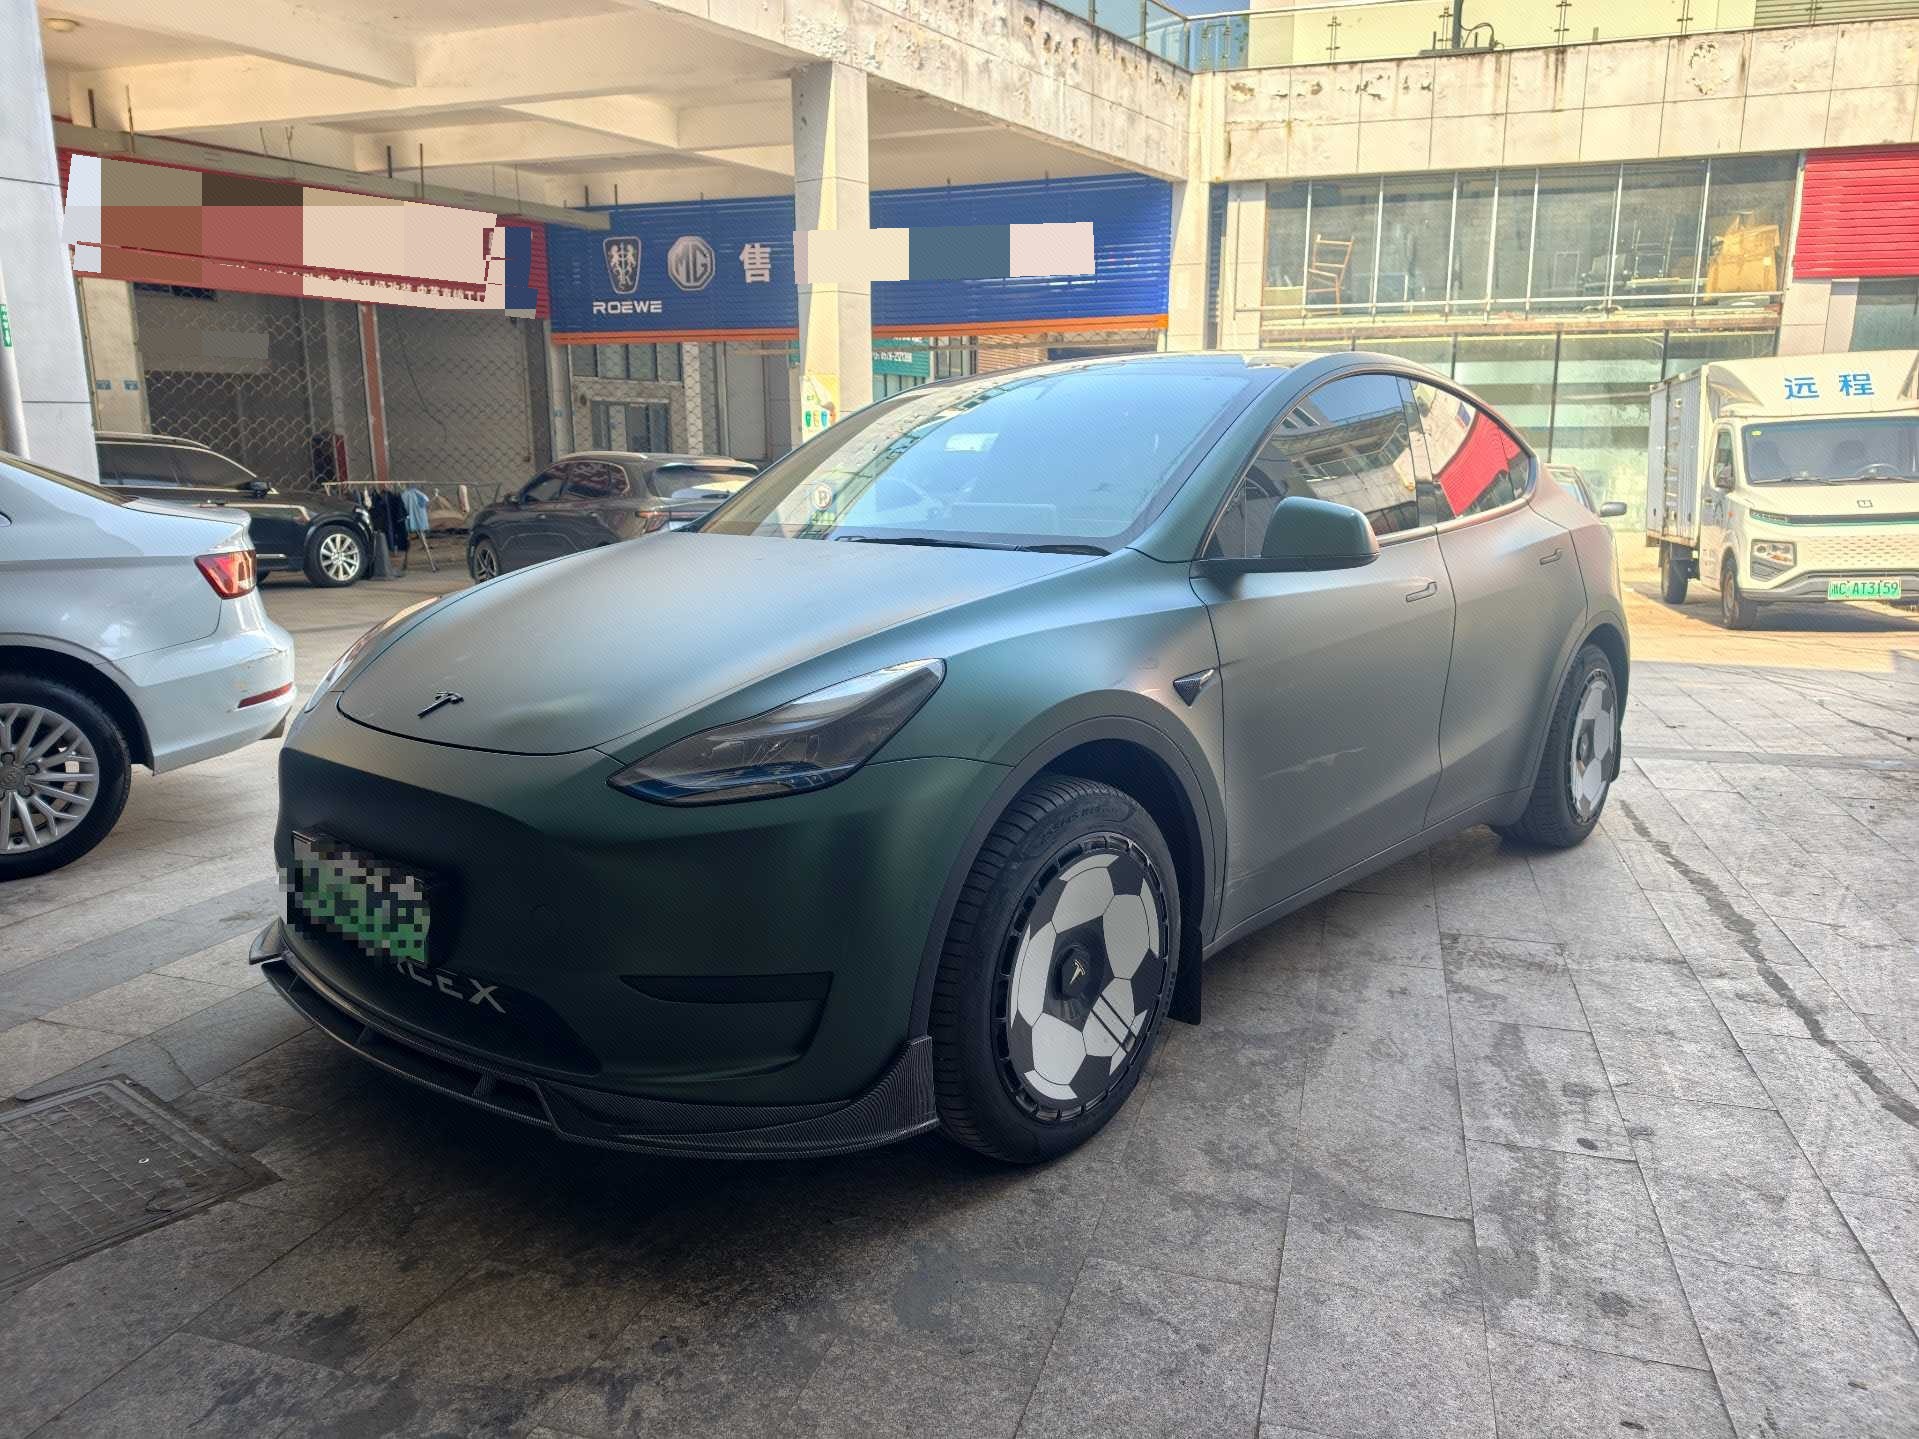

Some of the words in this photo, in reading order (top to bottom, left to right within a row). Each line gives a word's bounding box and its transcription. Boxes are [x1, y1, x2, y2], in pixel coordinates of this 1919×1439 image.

[671, 239, 713, 288] MG
[739, 243, 771, 283] 售
[593, 301, 662, 314] ROEWE
[1784, 373, 1875, 399] 远程
